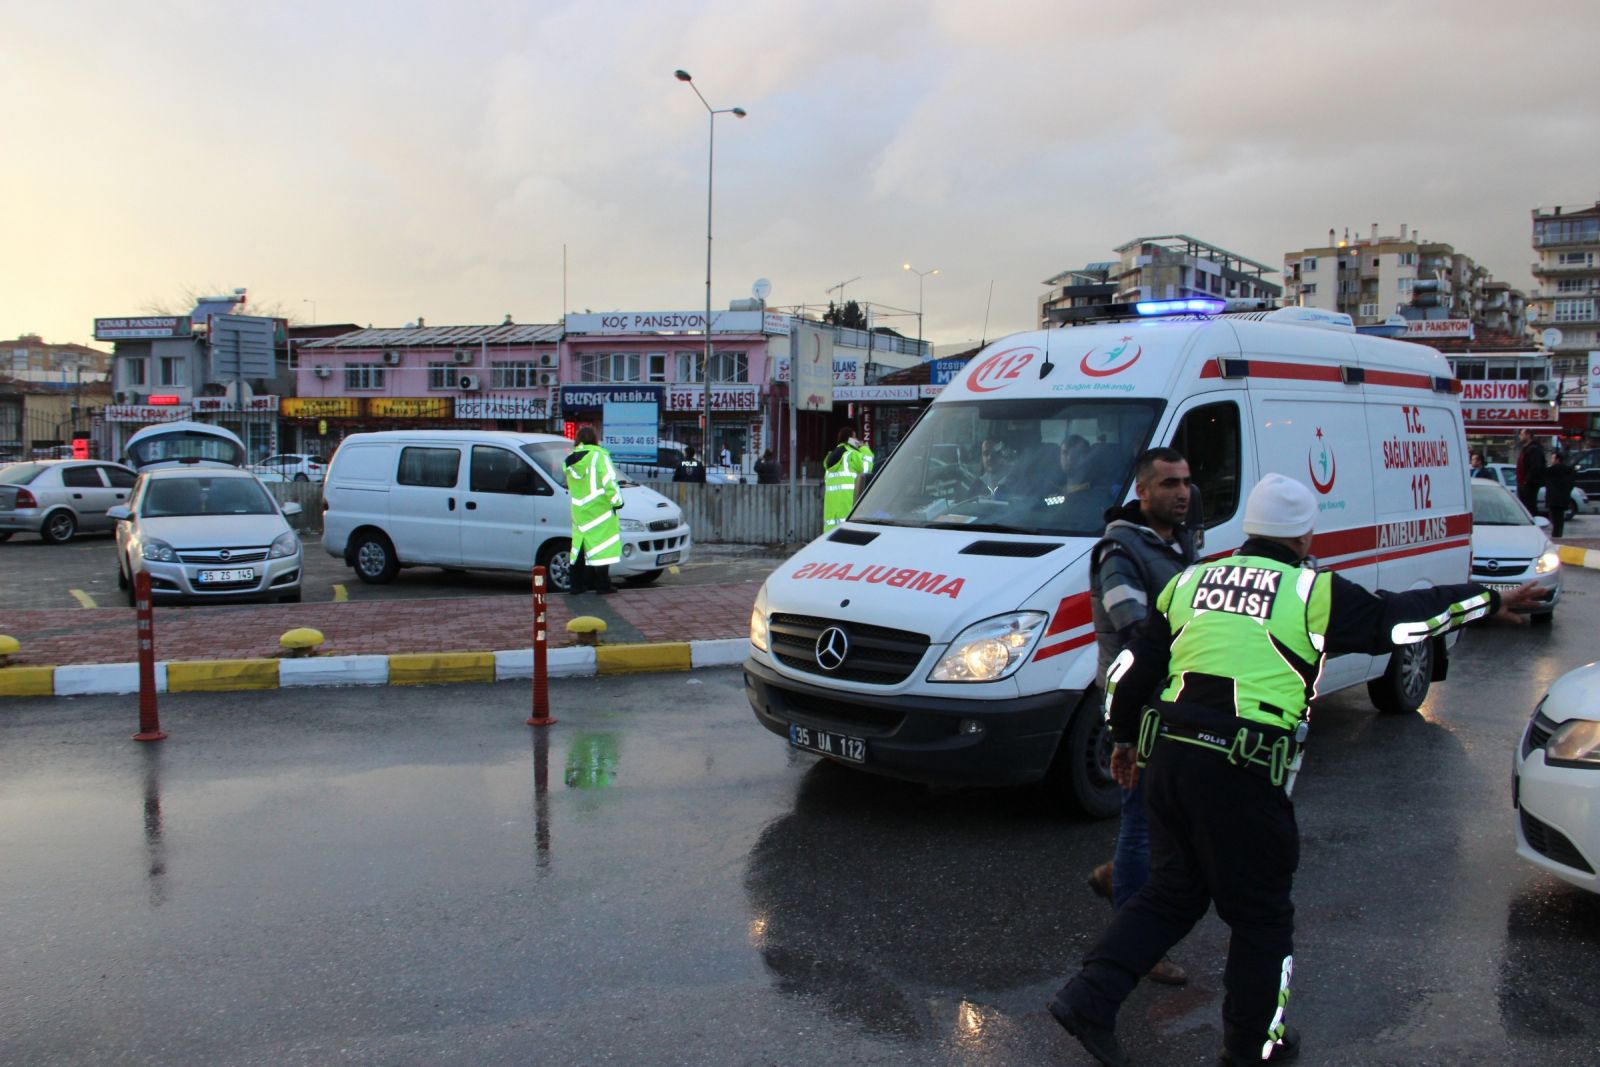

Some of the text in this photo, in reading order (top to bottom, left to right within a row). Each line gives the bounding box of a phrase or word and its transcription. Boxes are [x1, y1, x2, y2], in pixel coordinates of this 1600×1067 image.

[602, 313, 708, 329] KOÇ PANSİYON
[832, 361, 857, 373] ULANS
[979, 353, 1035, 382] 112
[671, 390, 755, 408] EGE EZANESİ
[1462, 381, 1528, 399] ANSİYON
[459, 402, 546, 416] KOÇ PANSİYON
[1402, 405, 1426, 433] T.C.
[1411, 474, 1432, 510] 112
[1379, 517, 1448, 548] AMBULANS
[203, 571, 214, 581] 35
[220, 570, 231, 580] ZS
[796, 726, 863, 760] 35 UA 112
